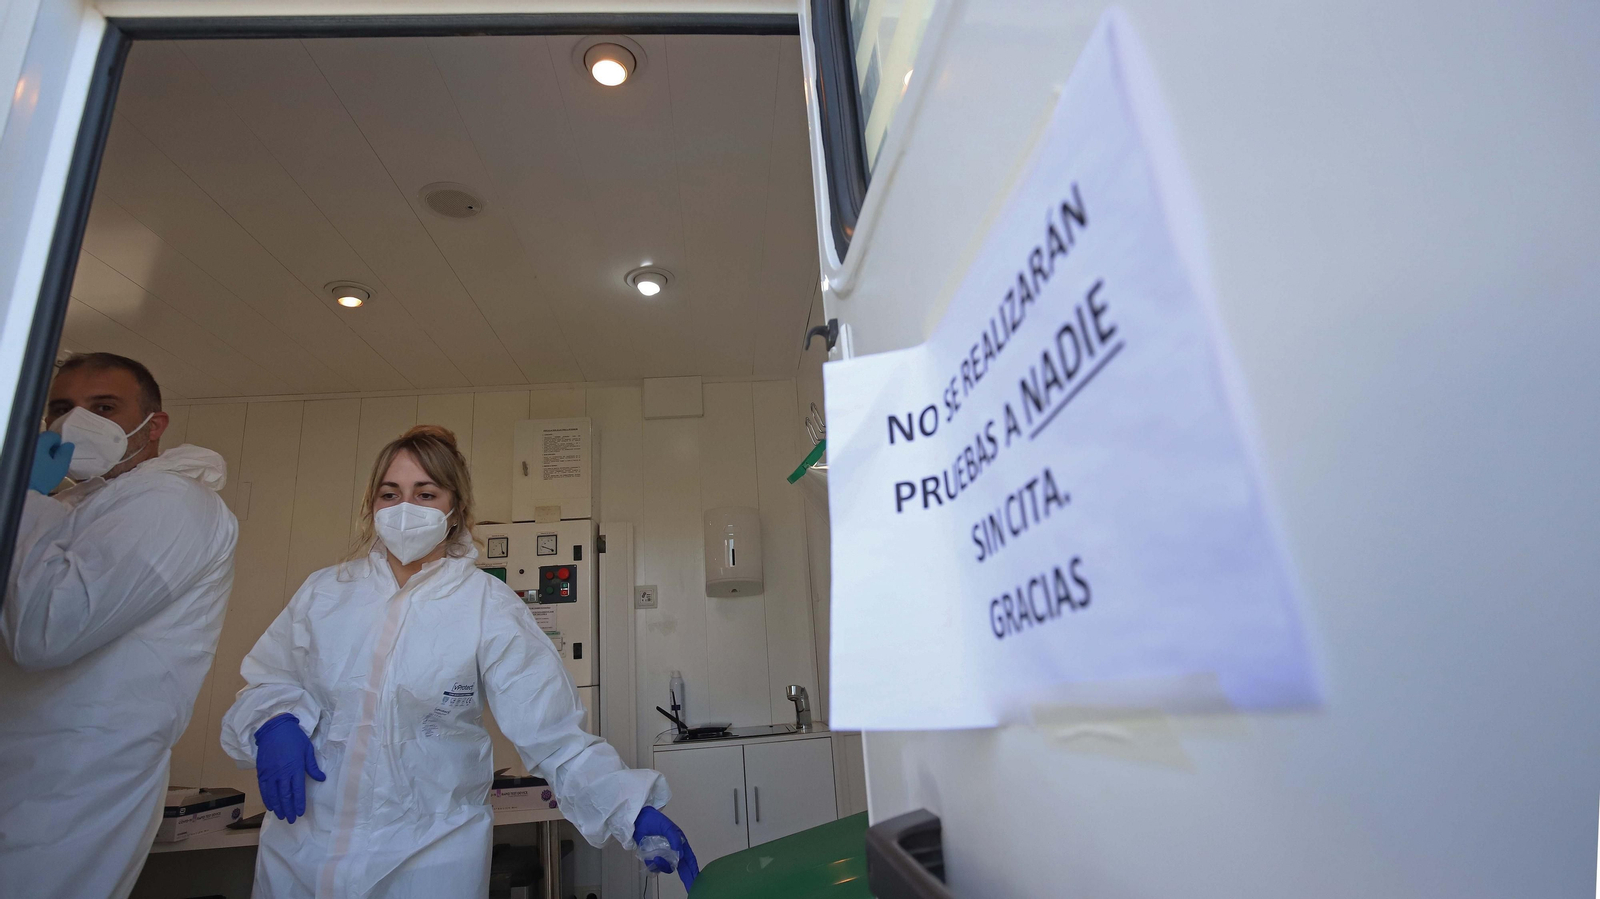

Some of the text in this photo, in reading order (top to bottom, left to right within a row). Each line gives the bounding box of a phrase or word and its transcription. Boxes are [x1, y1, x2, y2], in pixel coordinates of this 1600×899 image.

[887, 182, 1090, 446] NO SE REALIZARÁN
[894, 279, 1120, 514] PRUEBAS A NADIE
[971, 467, 1072, 564] SIN CITA.
[989, 555, 1092, 641] GRACIAS
